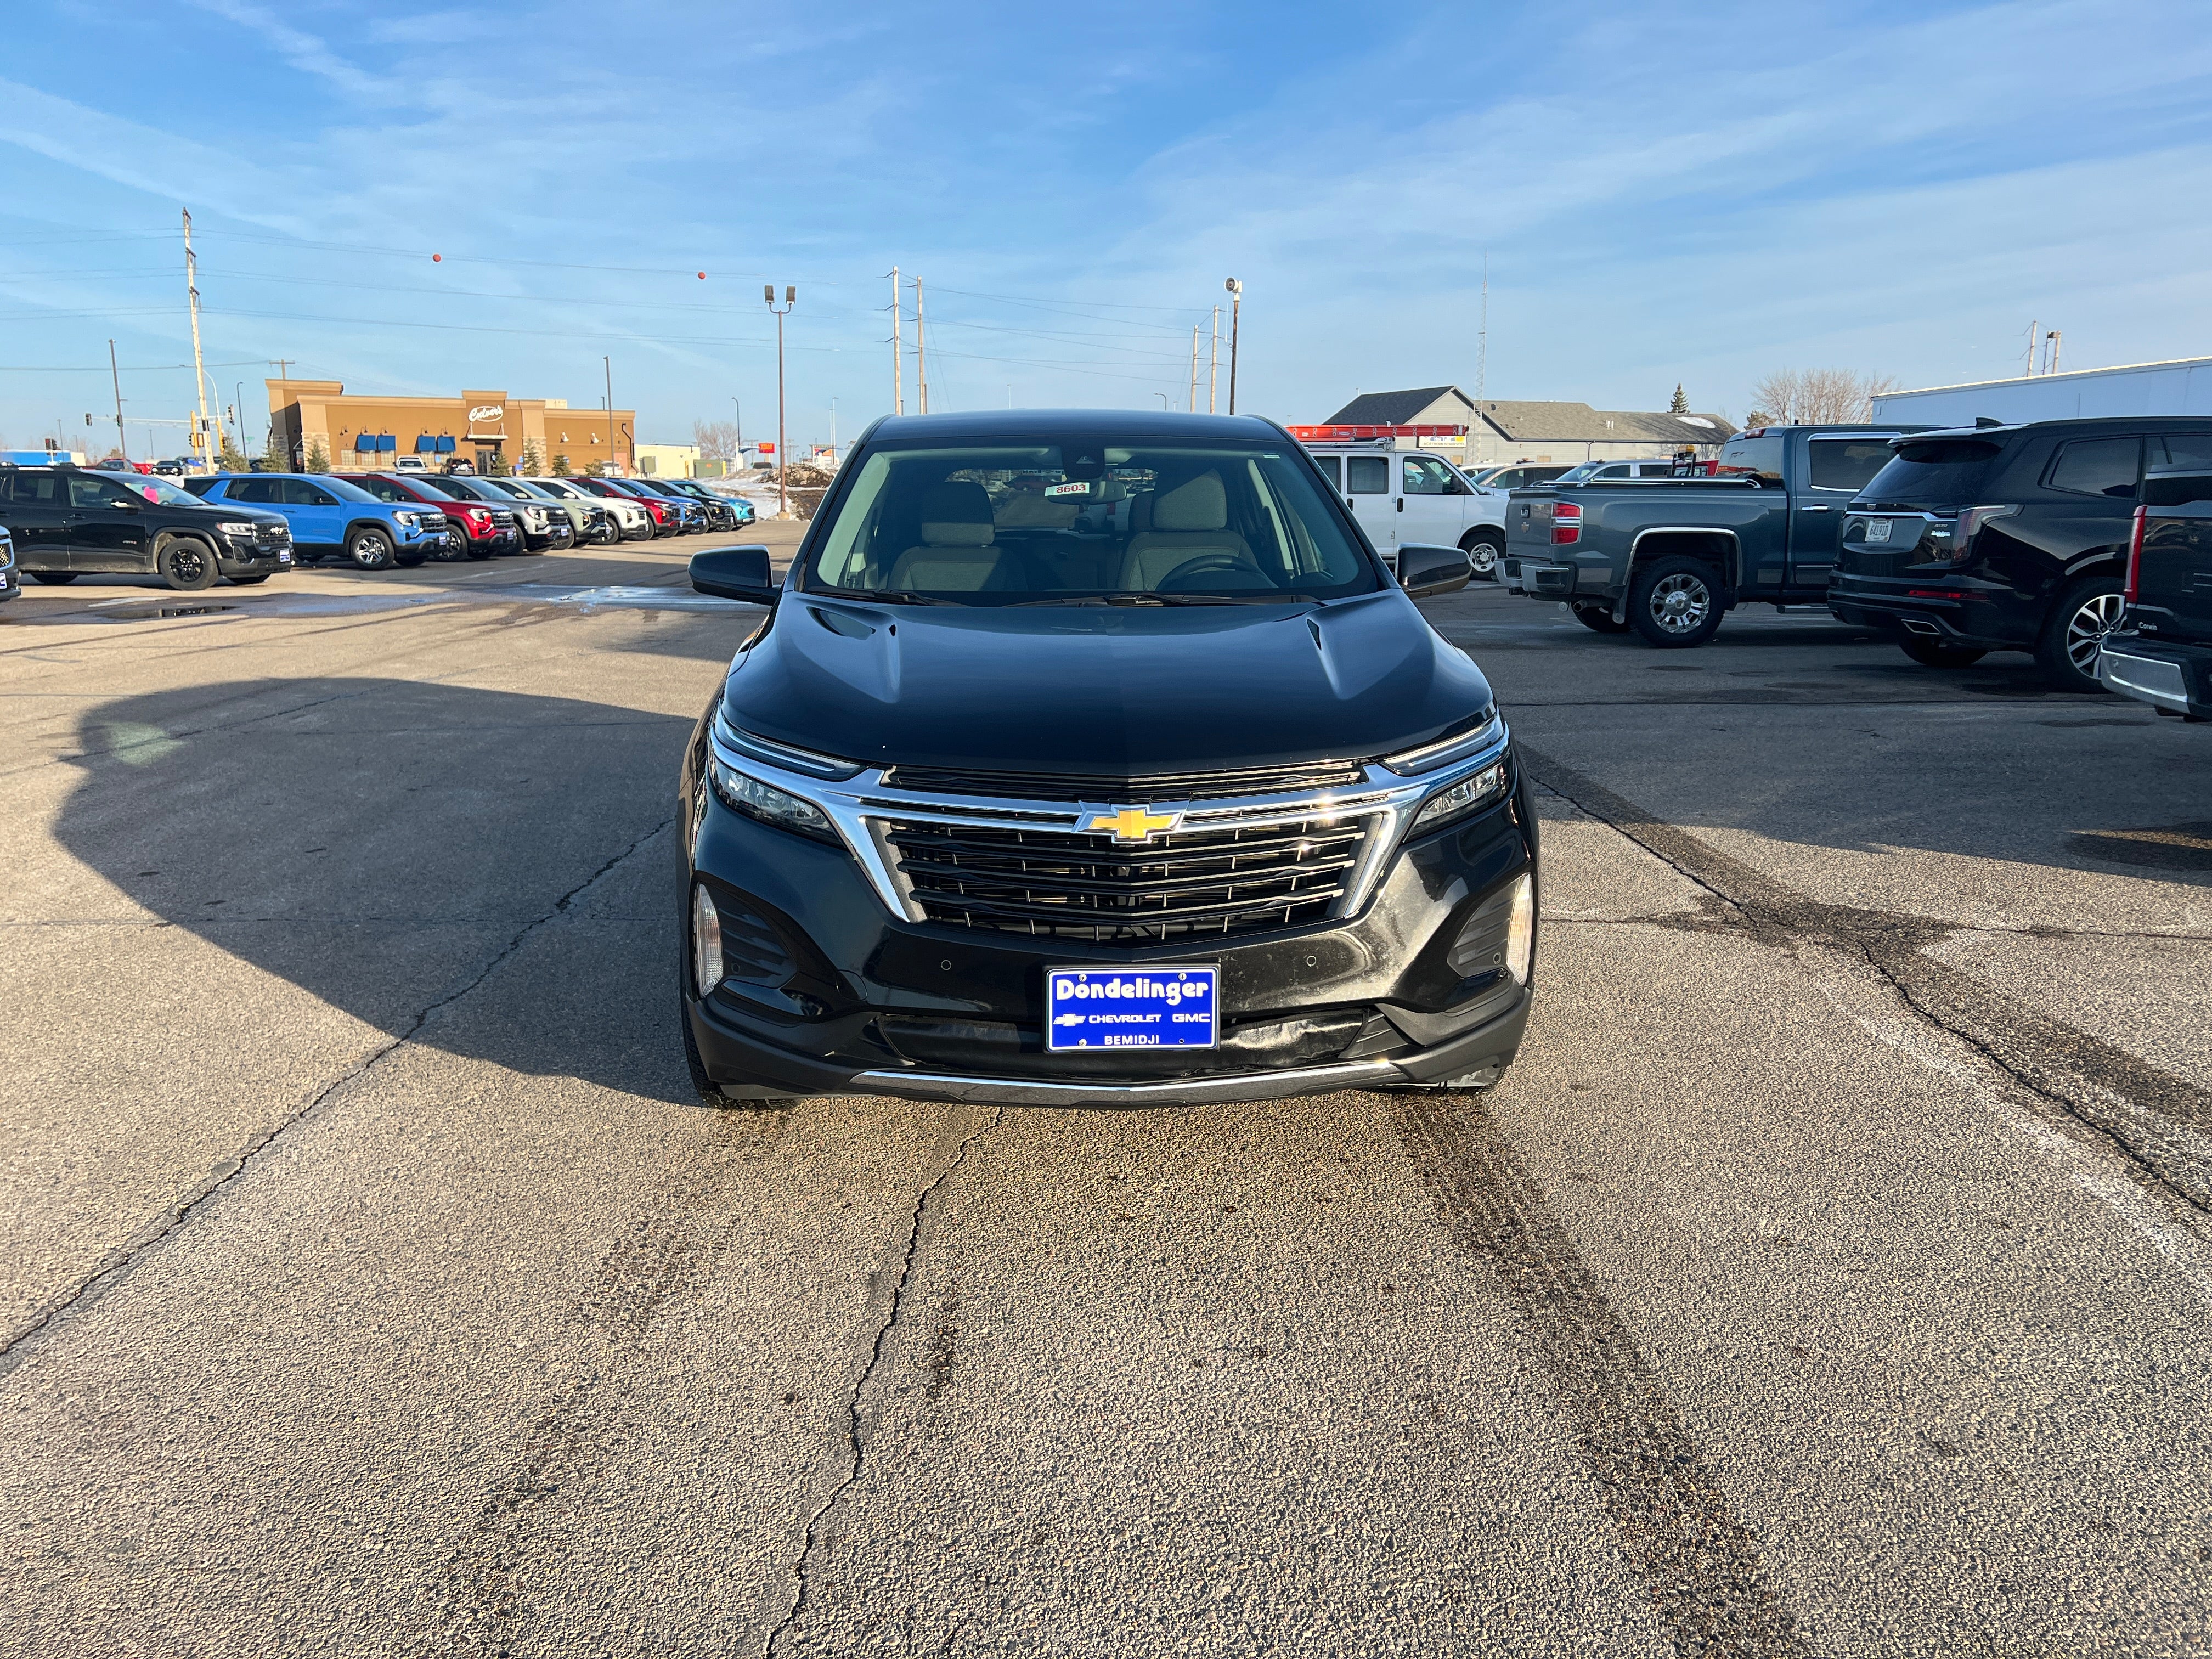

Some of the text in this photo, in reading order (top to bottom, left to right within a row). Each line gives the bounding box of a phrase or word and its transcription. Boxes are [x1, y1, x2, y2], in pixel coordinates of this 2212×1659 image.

[469, 405, 503, 422] Culver's
[1056, 484, 1086, 493] 8603
[1870, 525, 1889, 536] 64191D
[1056, 978, 1209, 1006] Dondelinger
[1088, 1013, 1210, 1024] CHEVROLET GMC
[1104, 1035, 1160, 1046] BEMIDJI
